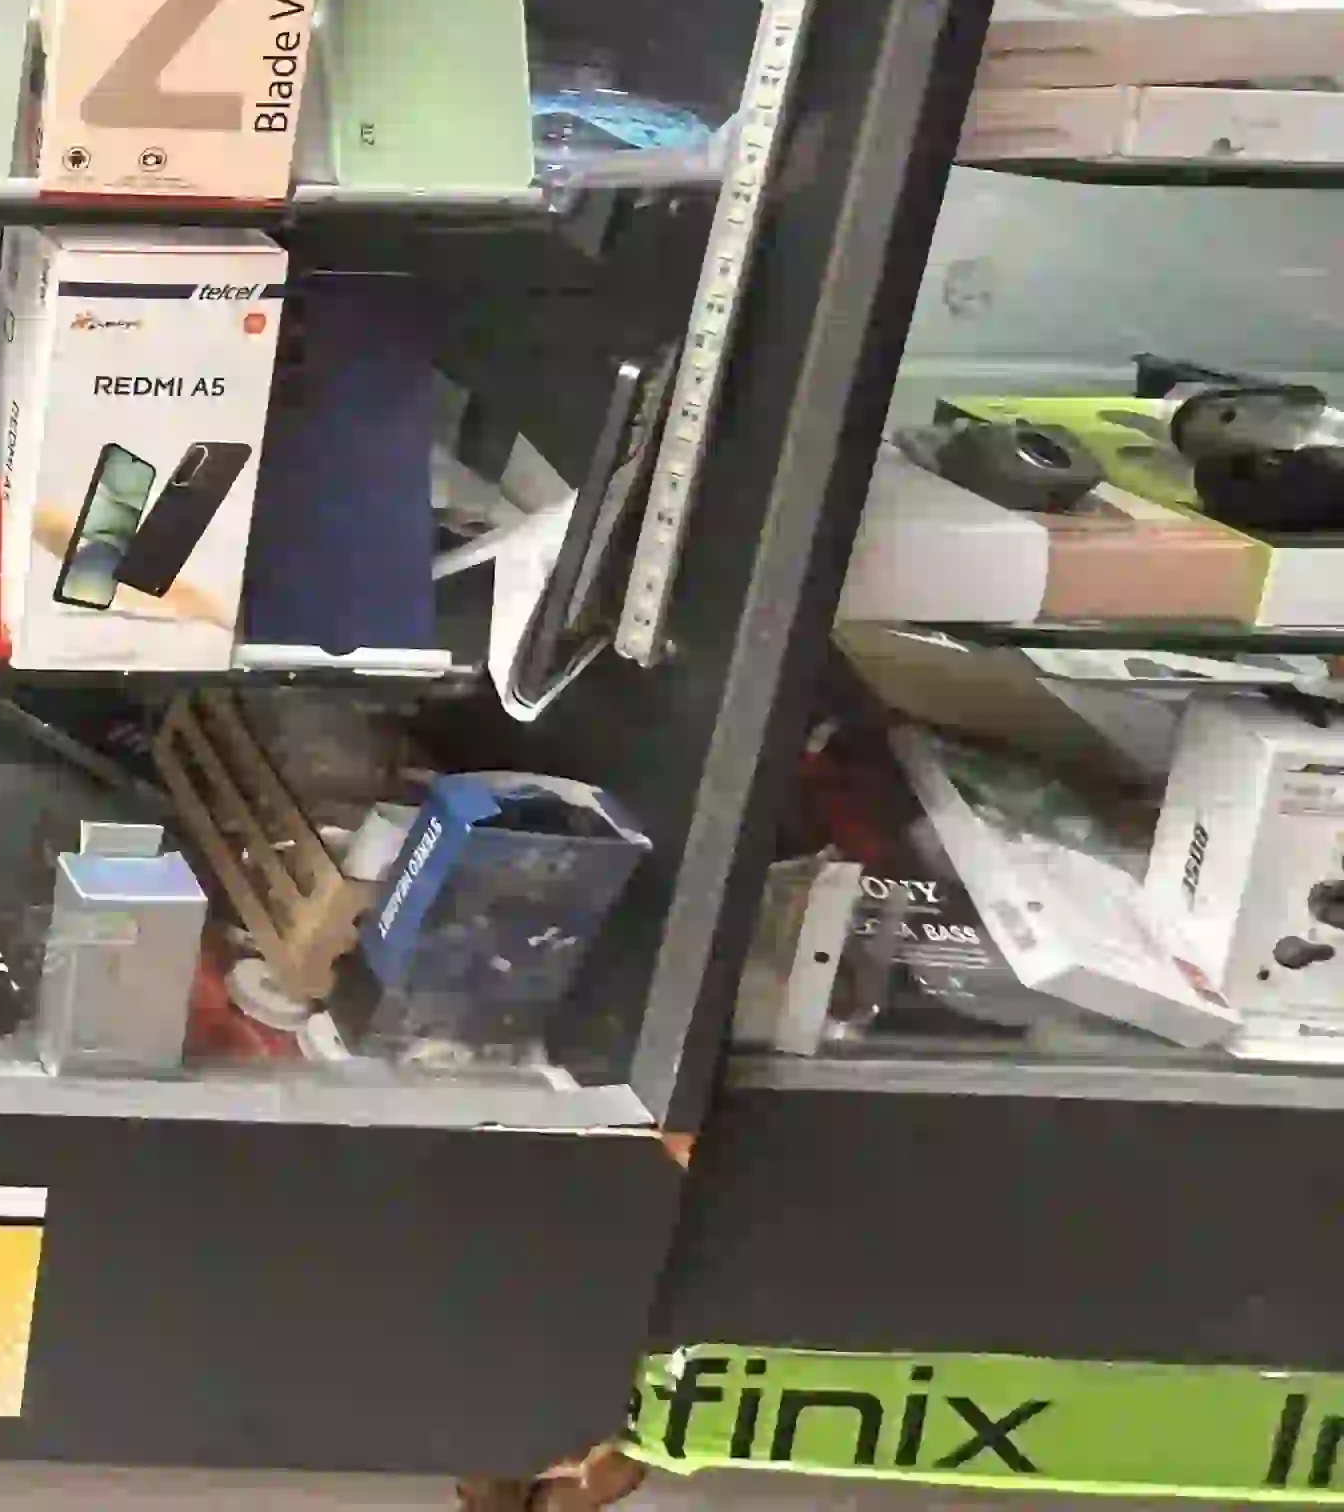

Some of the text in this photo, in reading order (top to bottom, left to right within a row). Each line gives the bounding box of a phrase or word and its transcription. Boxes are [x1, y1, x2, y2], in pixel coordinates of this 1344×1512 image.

[252, 31, 302, 133] Blade
[197, 282, 260, 302] telcel
[92, 374, 226, 398] REDMI A5
